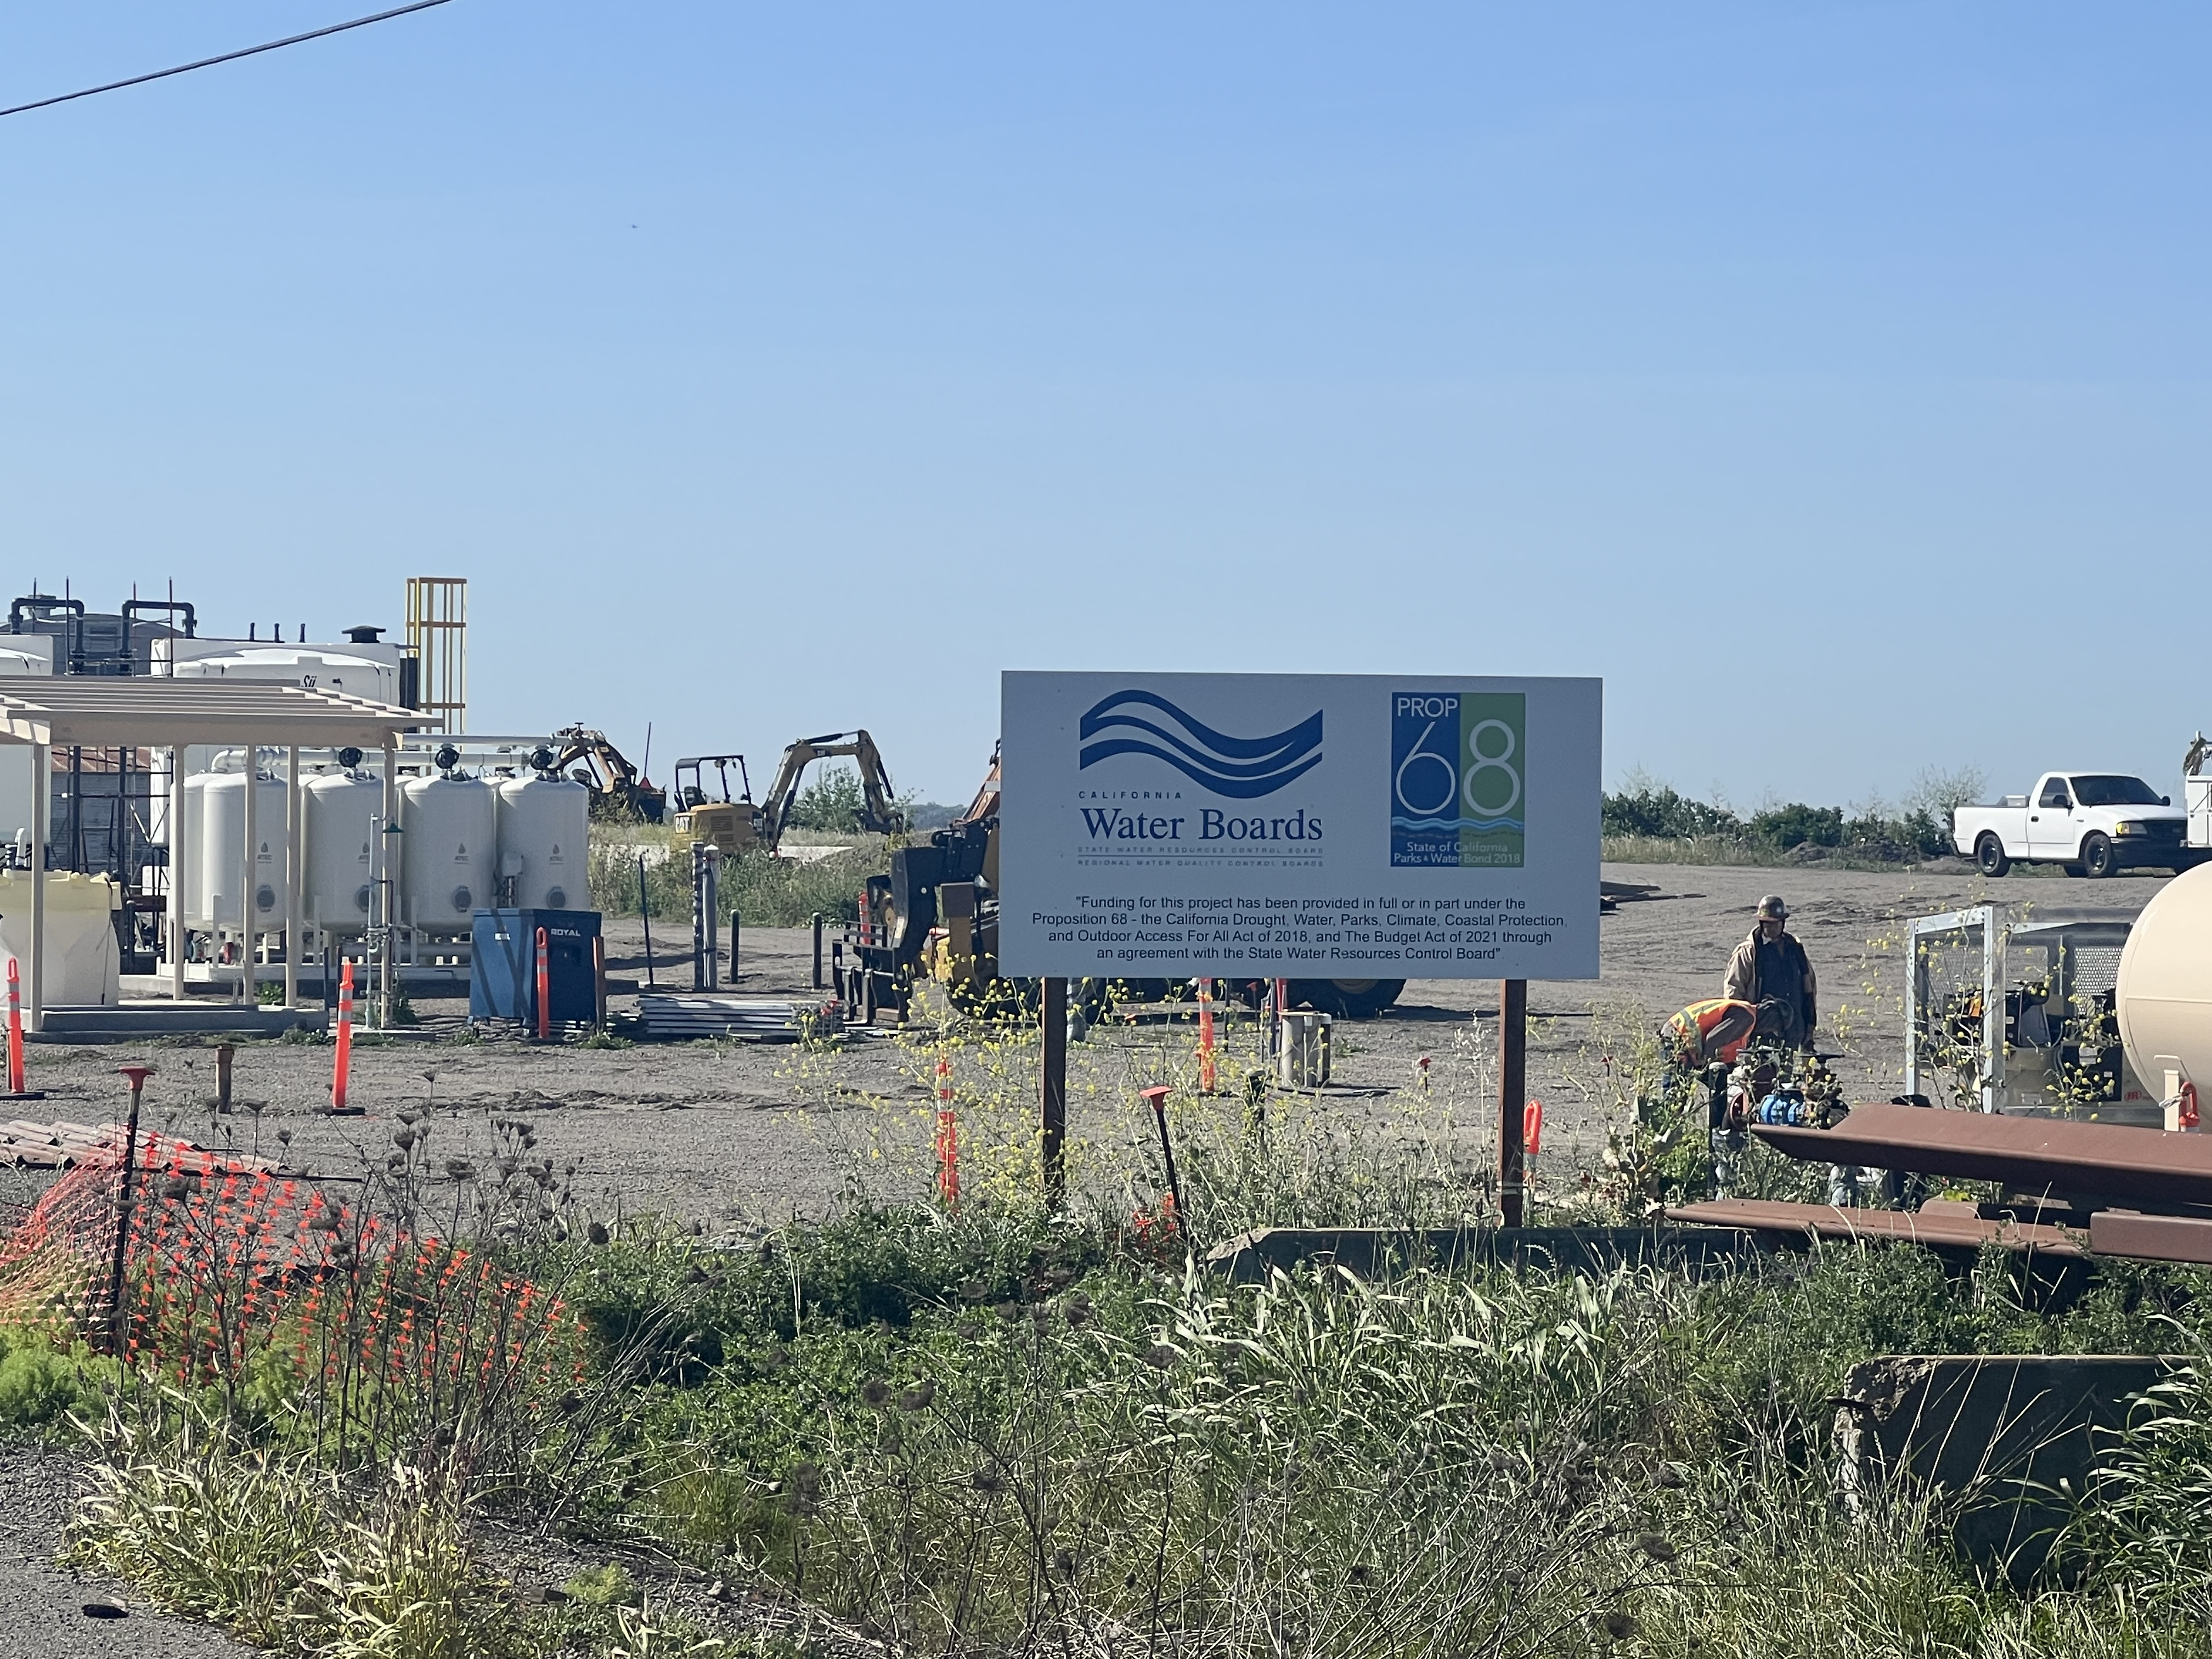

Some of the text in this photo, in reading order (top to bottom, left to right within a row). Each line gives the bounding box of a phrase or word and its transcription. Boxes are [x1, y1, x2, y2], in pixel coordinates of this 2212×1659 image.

[1397, 697, 1458, 718] PROP
[1396, 719, 1521, 816] 68
[1078, 791, 1182, 799] CALIFORNIA
[1079, 808, 1323, 840] Water Boards
[1407, 841, 1508, 852] State of California
[1393, 853, 1422, 864] Parks
[1431, 854, 1462, 864] Water
[1464, 853, 1492, 864] Bond
[1494, 853, 1521, 864] 2018
[1075, 895, 1526, 912] "Funding for this project has been provided in full or in part under the
[1032, 912, 1107, 928] Proposition
[1111, 912, 1127, 925] 68
[1141, 913, 1161, 925] the
[1166, 912, 1228, 925] California
[1233, 913, 1289, 928] Drought,
[1294, 913, 1336, 927] Water,
[1341, 913, 1382, 927] Parks,
[1386, 913, 1440, 928] Climate,
[1444, 913, 1494, 926] Coastal
[1498, 913, 1568, 928] Protection,
[550, 928, 581, 937] ROYAL
[1048, 929, 1551, 946] and Outdoor Access For All Act of 2018, and The Budget Act of 2021 through
[1097, 946, 1501, 962] an agreement with the State Water Resources Control Board"
